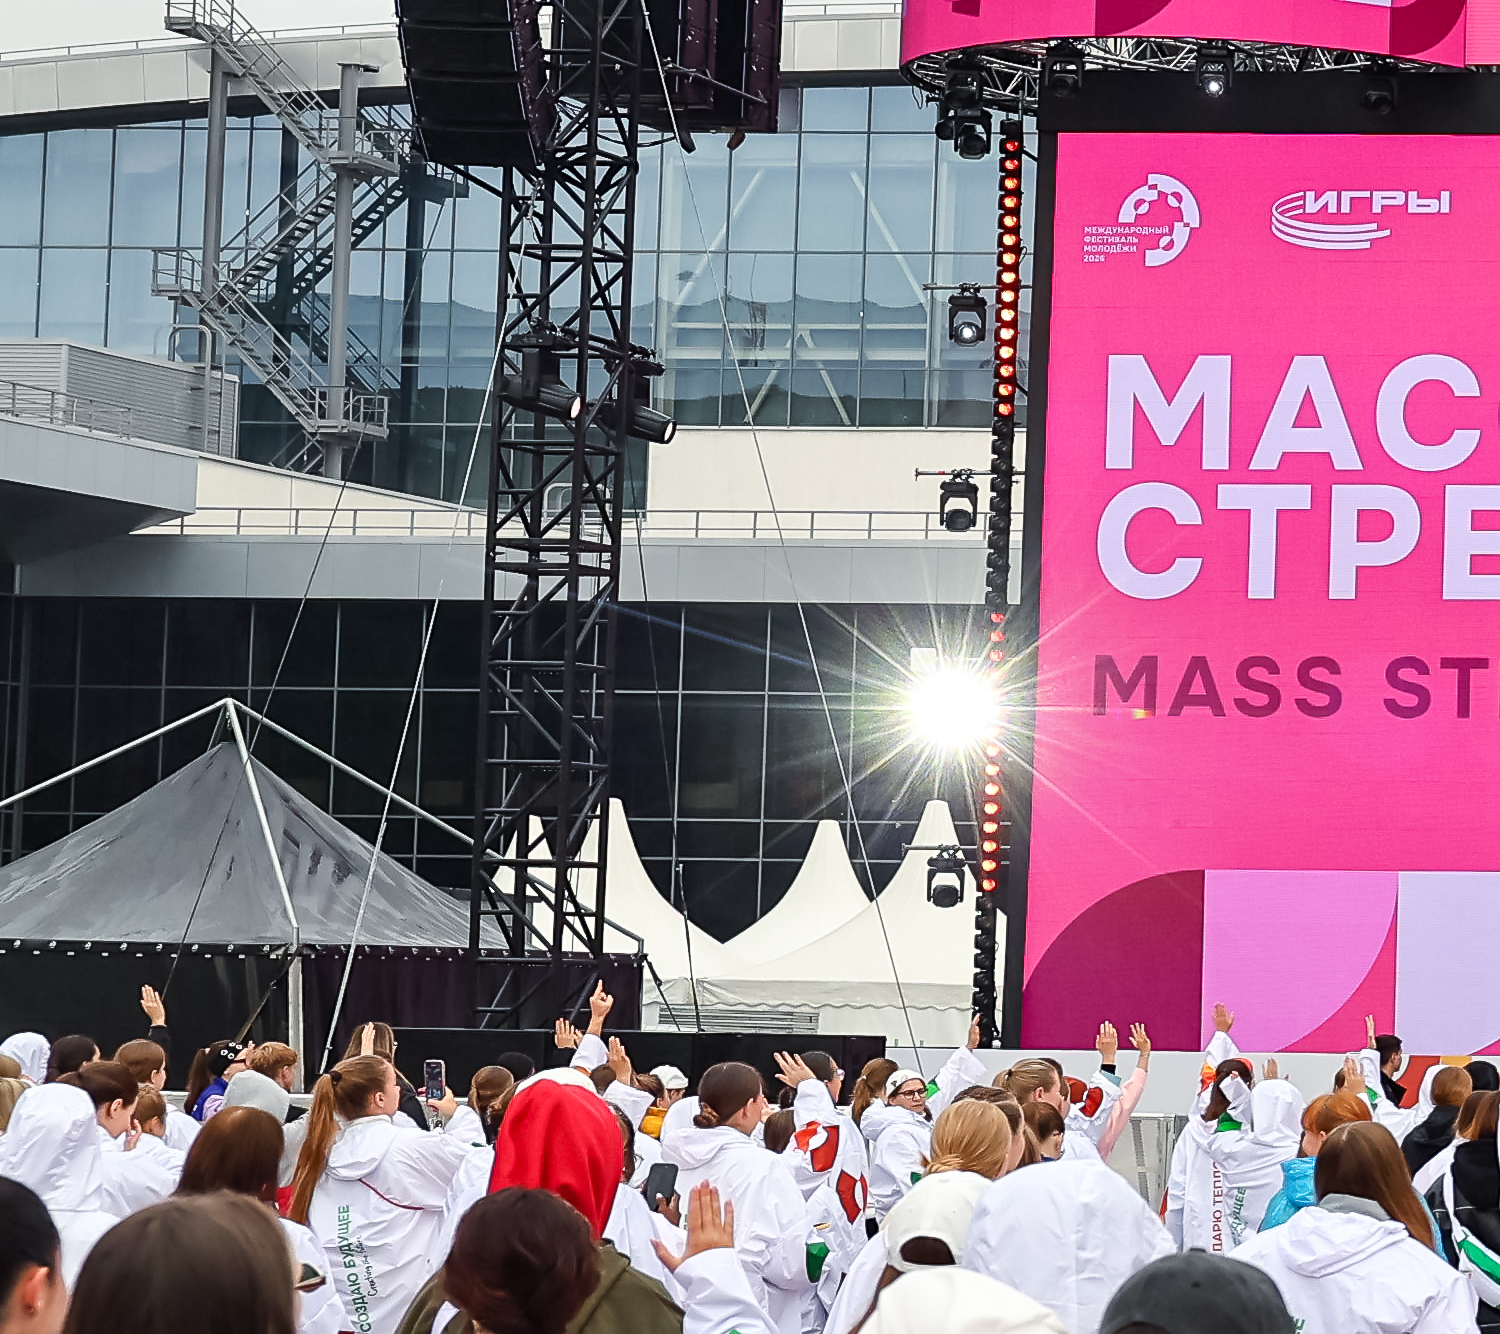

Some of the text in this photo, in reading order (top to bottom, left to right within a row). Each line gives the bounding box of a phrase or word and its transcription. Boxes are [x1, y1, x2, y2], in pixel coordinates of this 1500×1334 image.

[1304, 190, 1451, 214] ИГРЫ
[1093, 654, 1343, 717] MASS
[337, 1205, 372, 1333] СОЗДАЮ БУДУЩЕЕ
